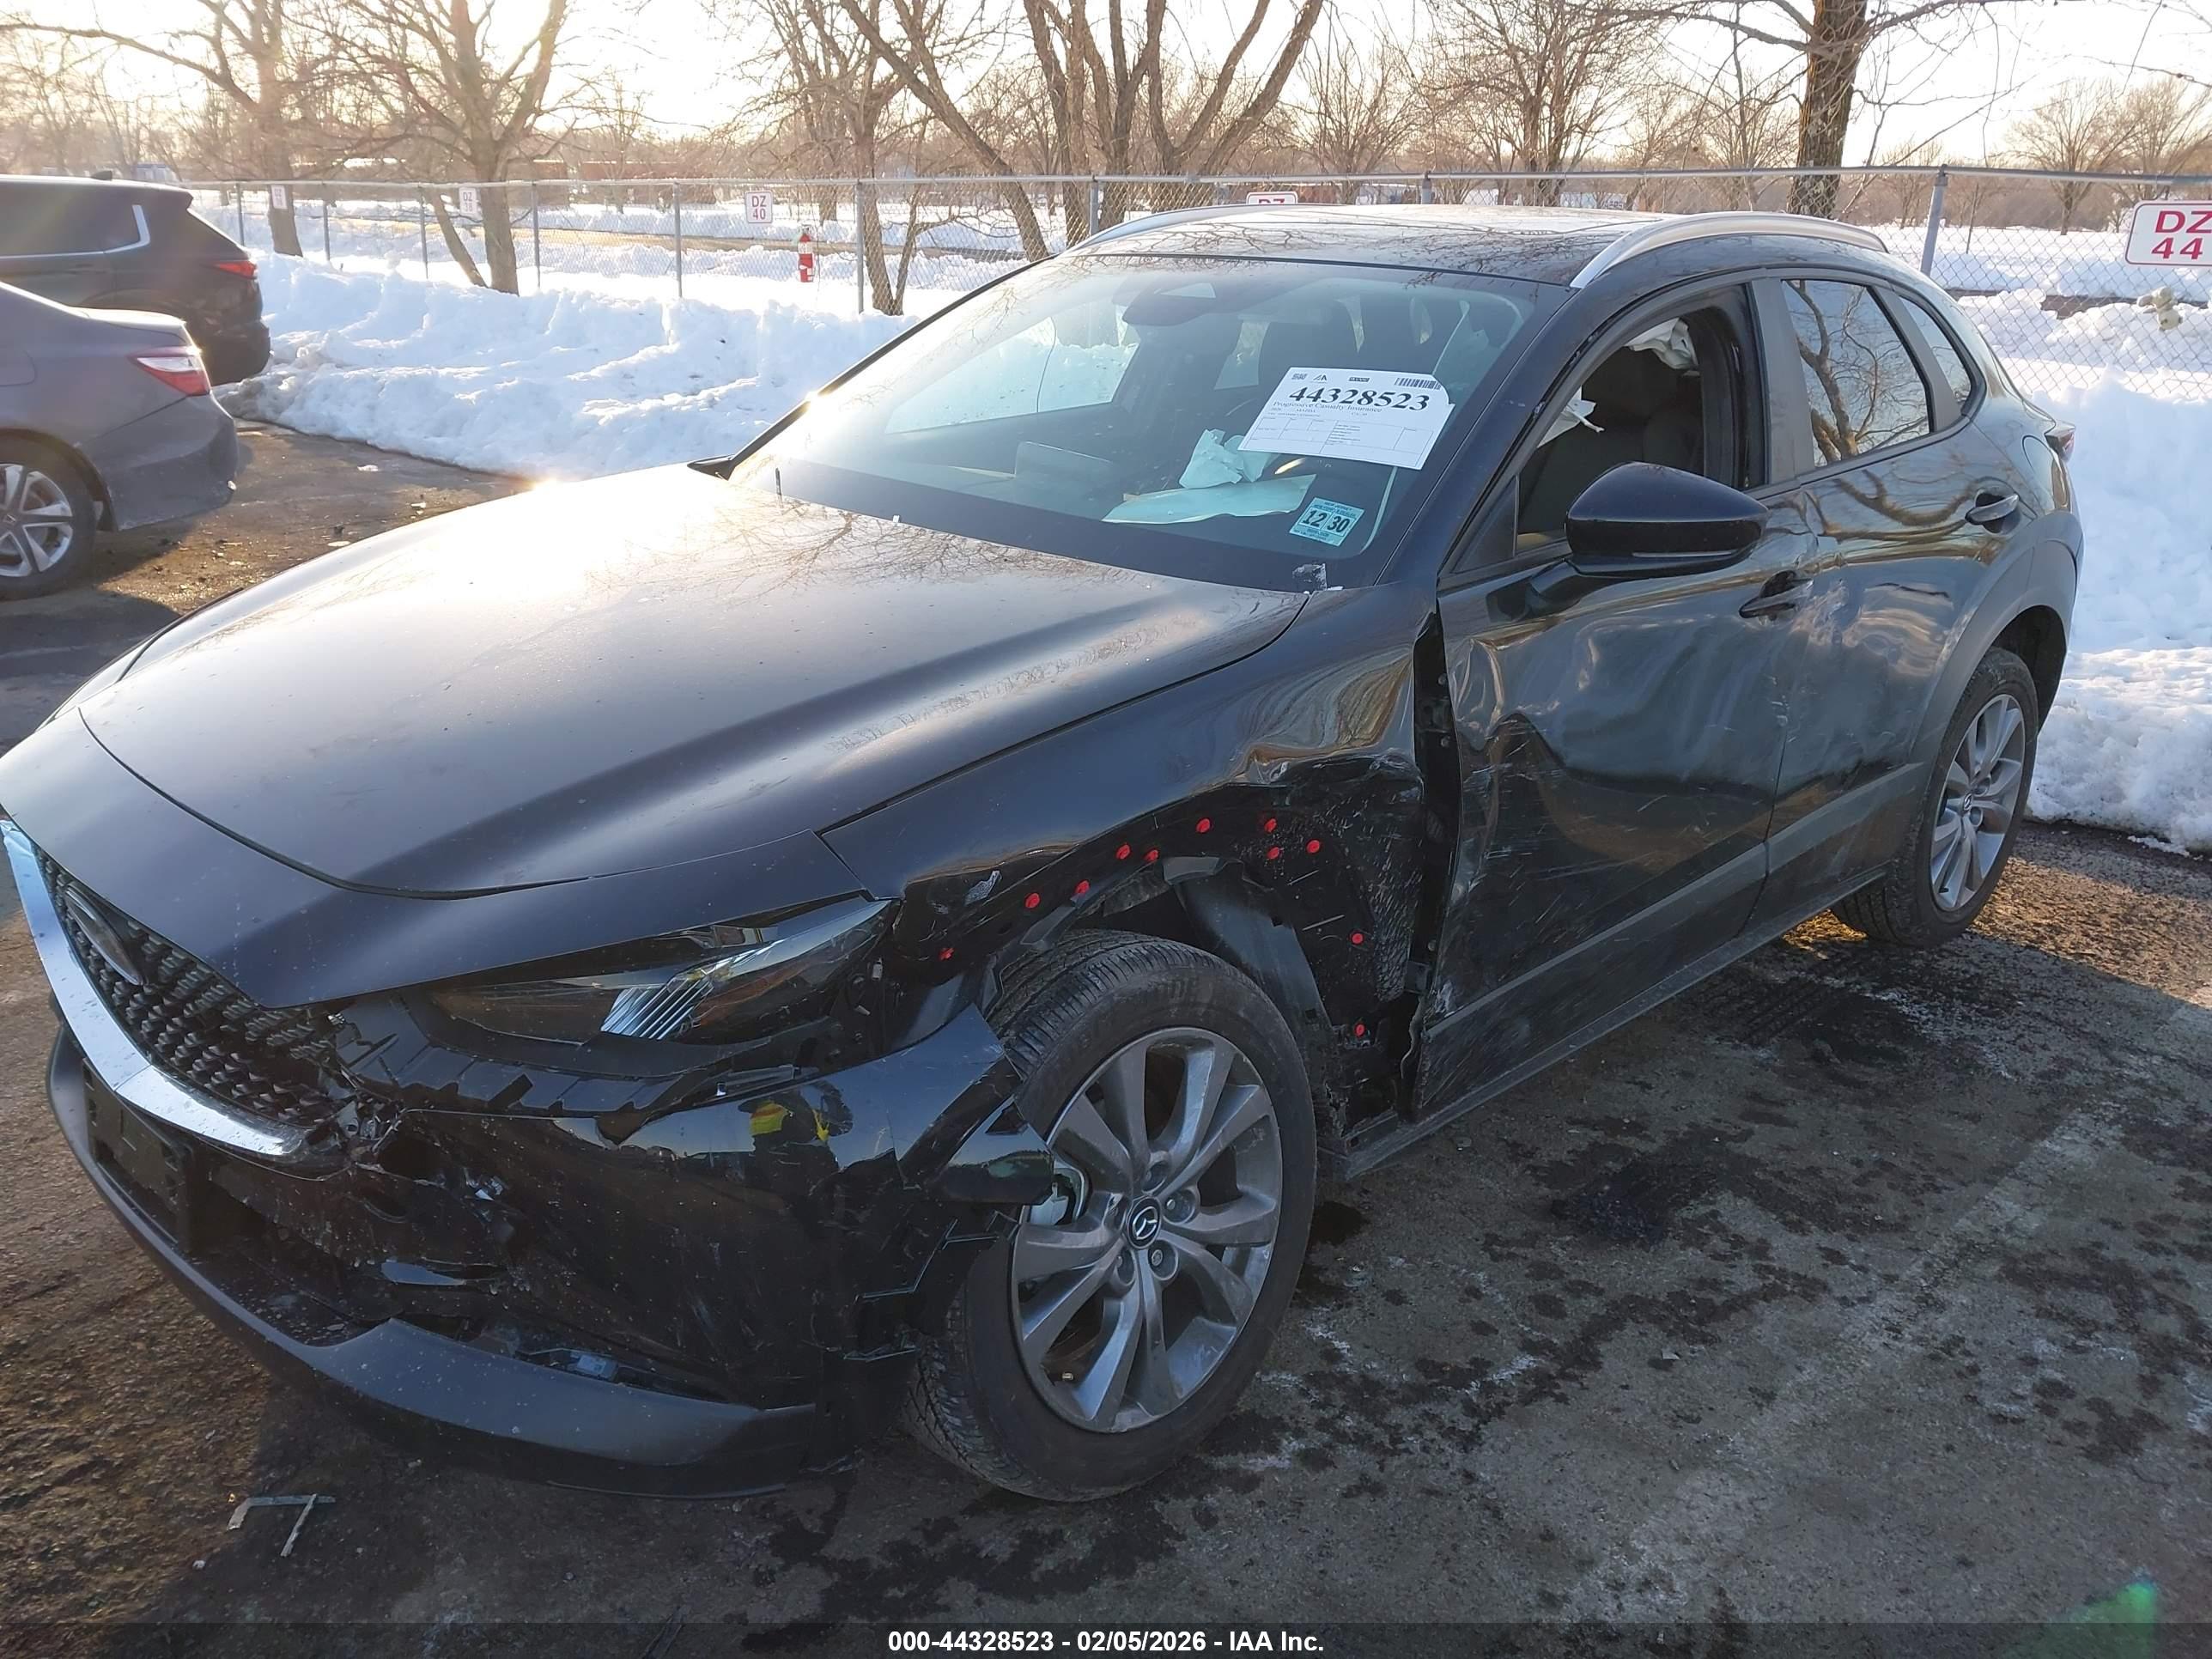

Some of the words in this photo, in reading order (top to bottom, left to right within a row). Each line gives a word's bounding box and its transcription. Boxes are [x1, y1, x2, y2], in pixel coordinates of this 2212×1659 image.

[463, 191, 473, 202] DZ
[751, 195, 767, 207] DZ
[752, 208, 767, 220] 40
[2154, 210, 2212, 234] DZ
[2151, 237, 2203, 260] 44
[1289, 386, 1430, 411] 44328523
[1315, 402, 1345, 410] Casualty
[1302, 509, 1328, 527] 12
[1327, 515, 1350, 533] 30
